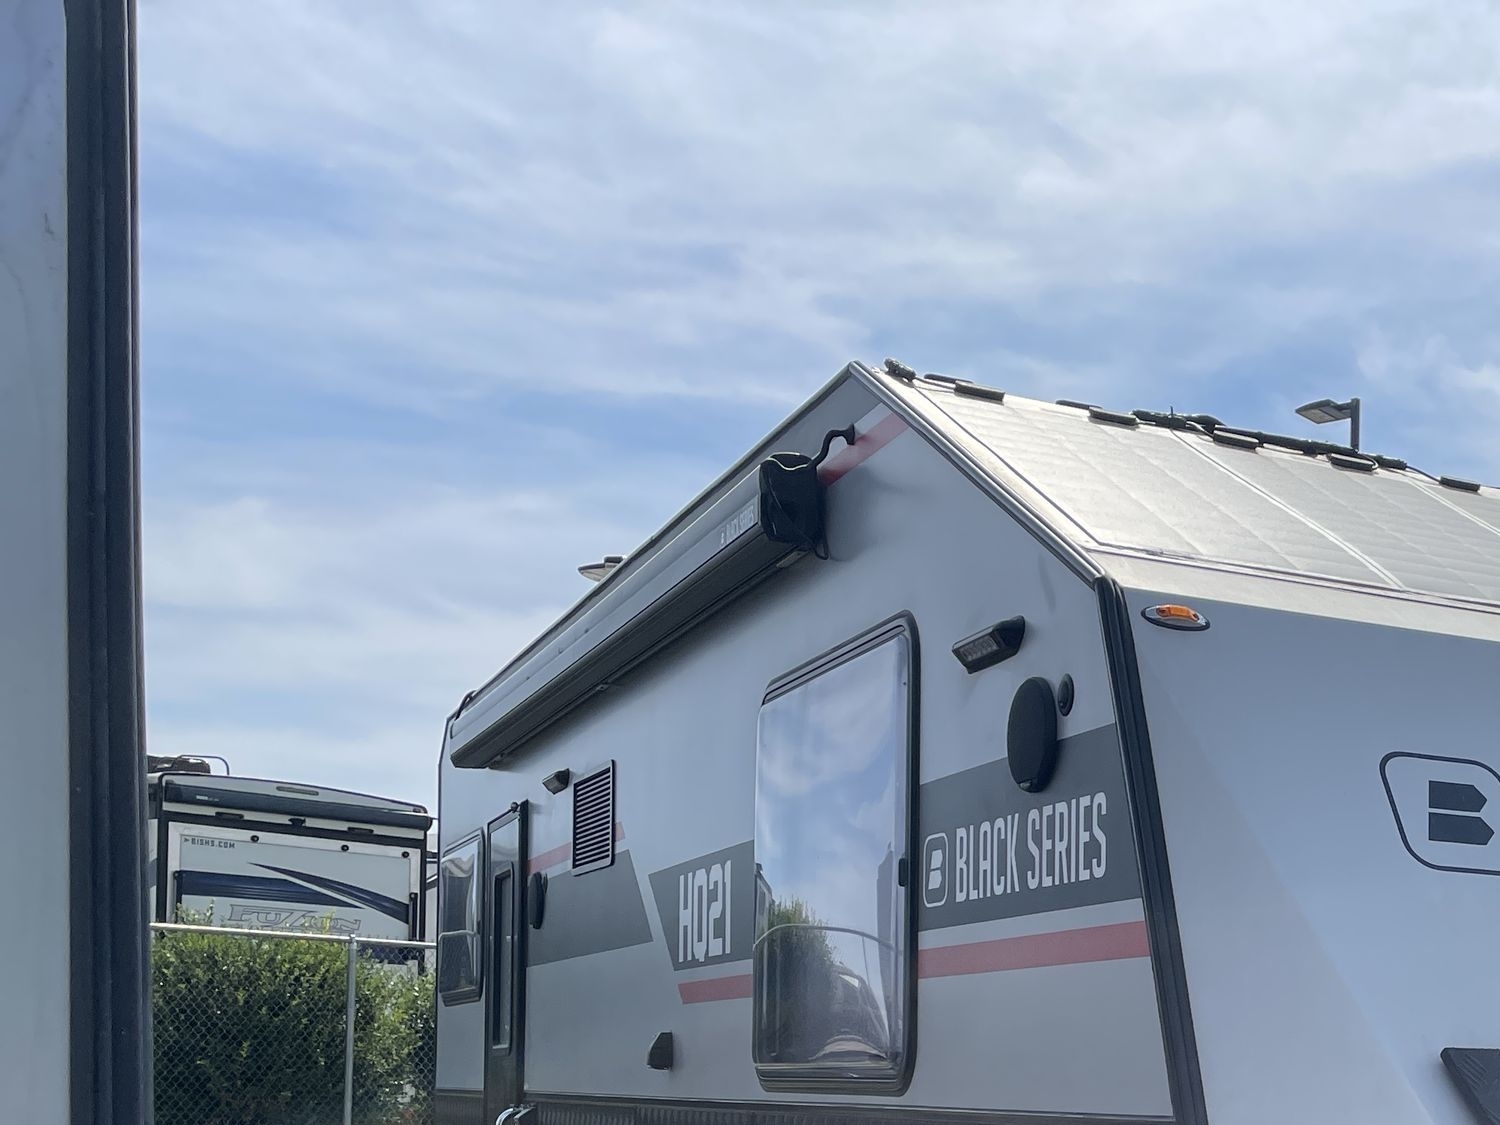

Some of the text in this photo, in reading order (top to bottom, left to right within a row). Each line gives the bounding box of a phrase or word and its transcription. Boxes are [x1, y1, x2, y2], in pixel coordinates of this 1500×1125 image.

[955, 791, 1108, 903] BLACK SERIES
[678, 858, 734, 964] HQ21
